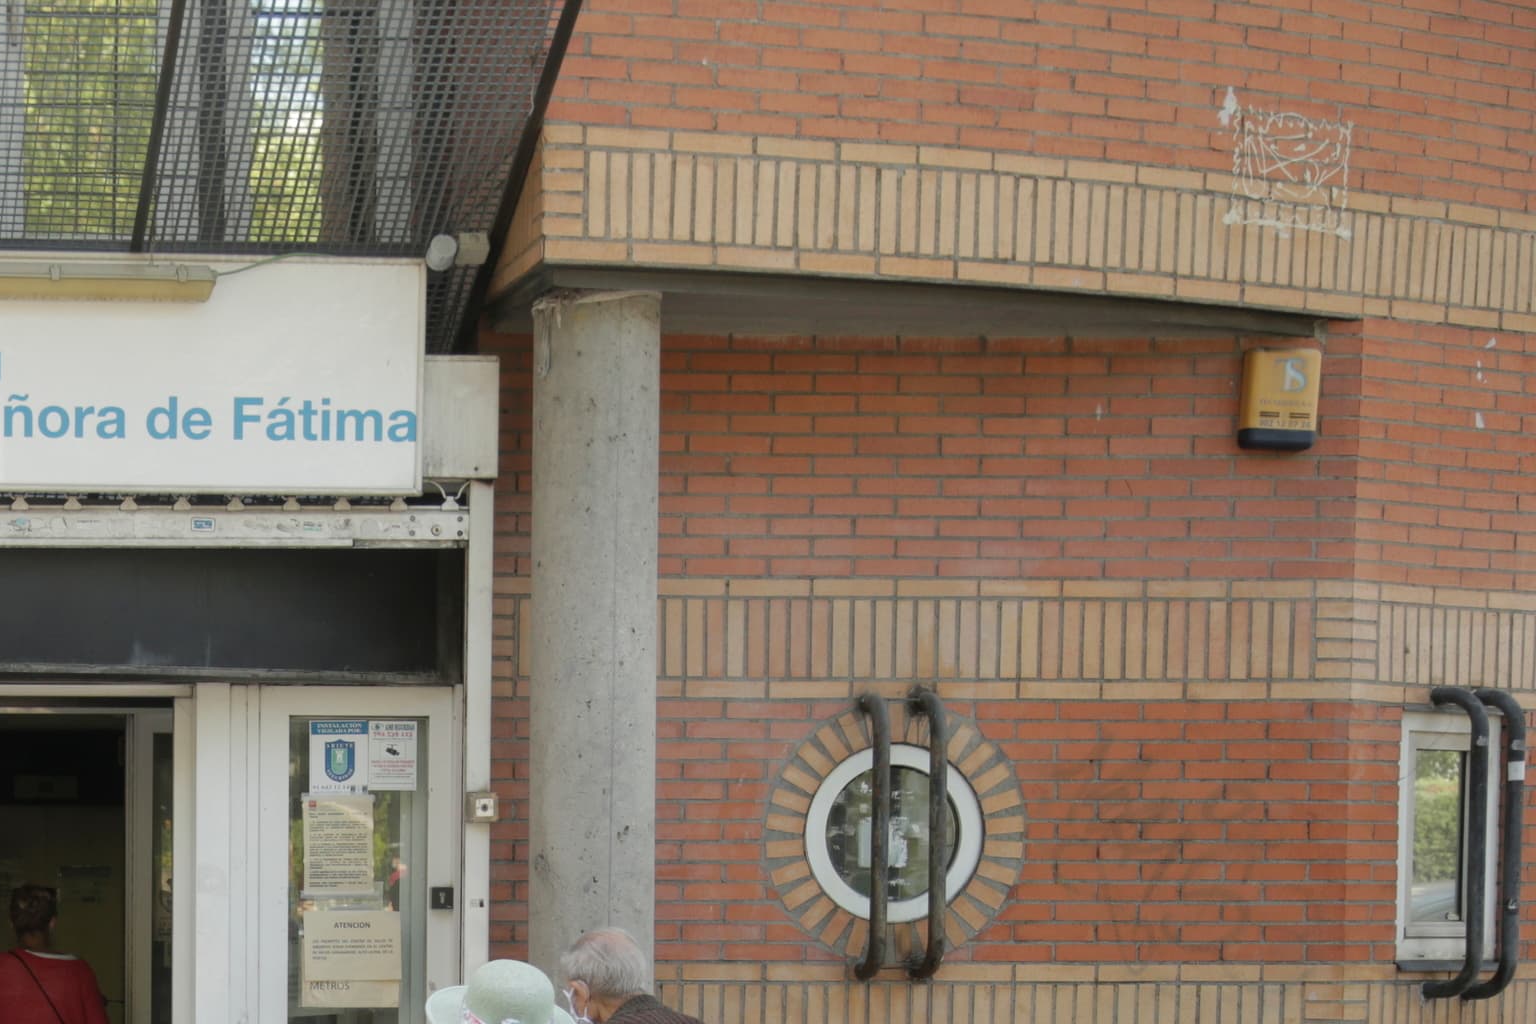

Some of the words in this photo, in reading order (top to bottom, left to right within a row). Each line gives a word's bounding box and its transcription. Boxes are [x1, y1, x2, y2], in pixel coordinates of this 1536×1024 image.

[146, 396, 213, 441] de
[233, 396, 417, 443] Fátima
[310, 980, 350, 991] METROS
